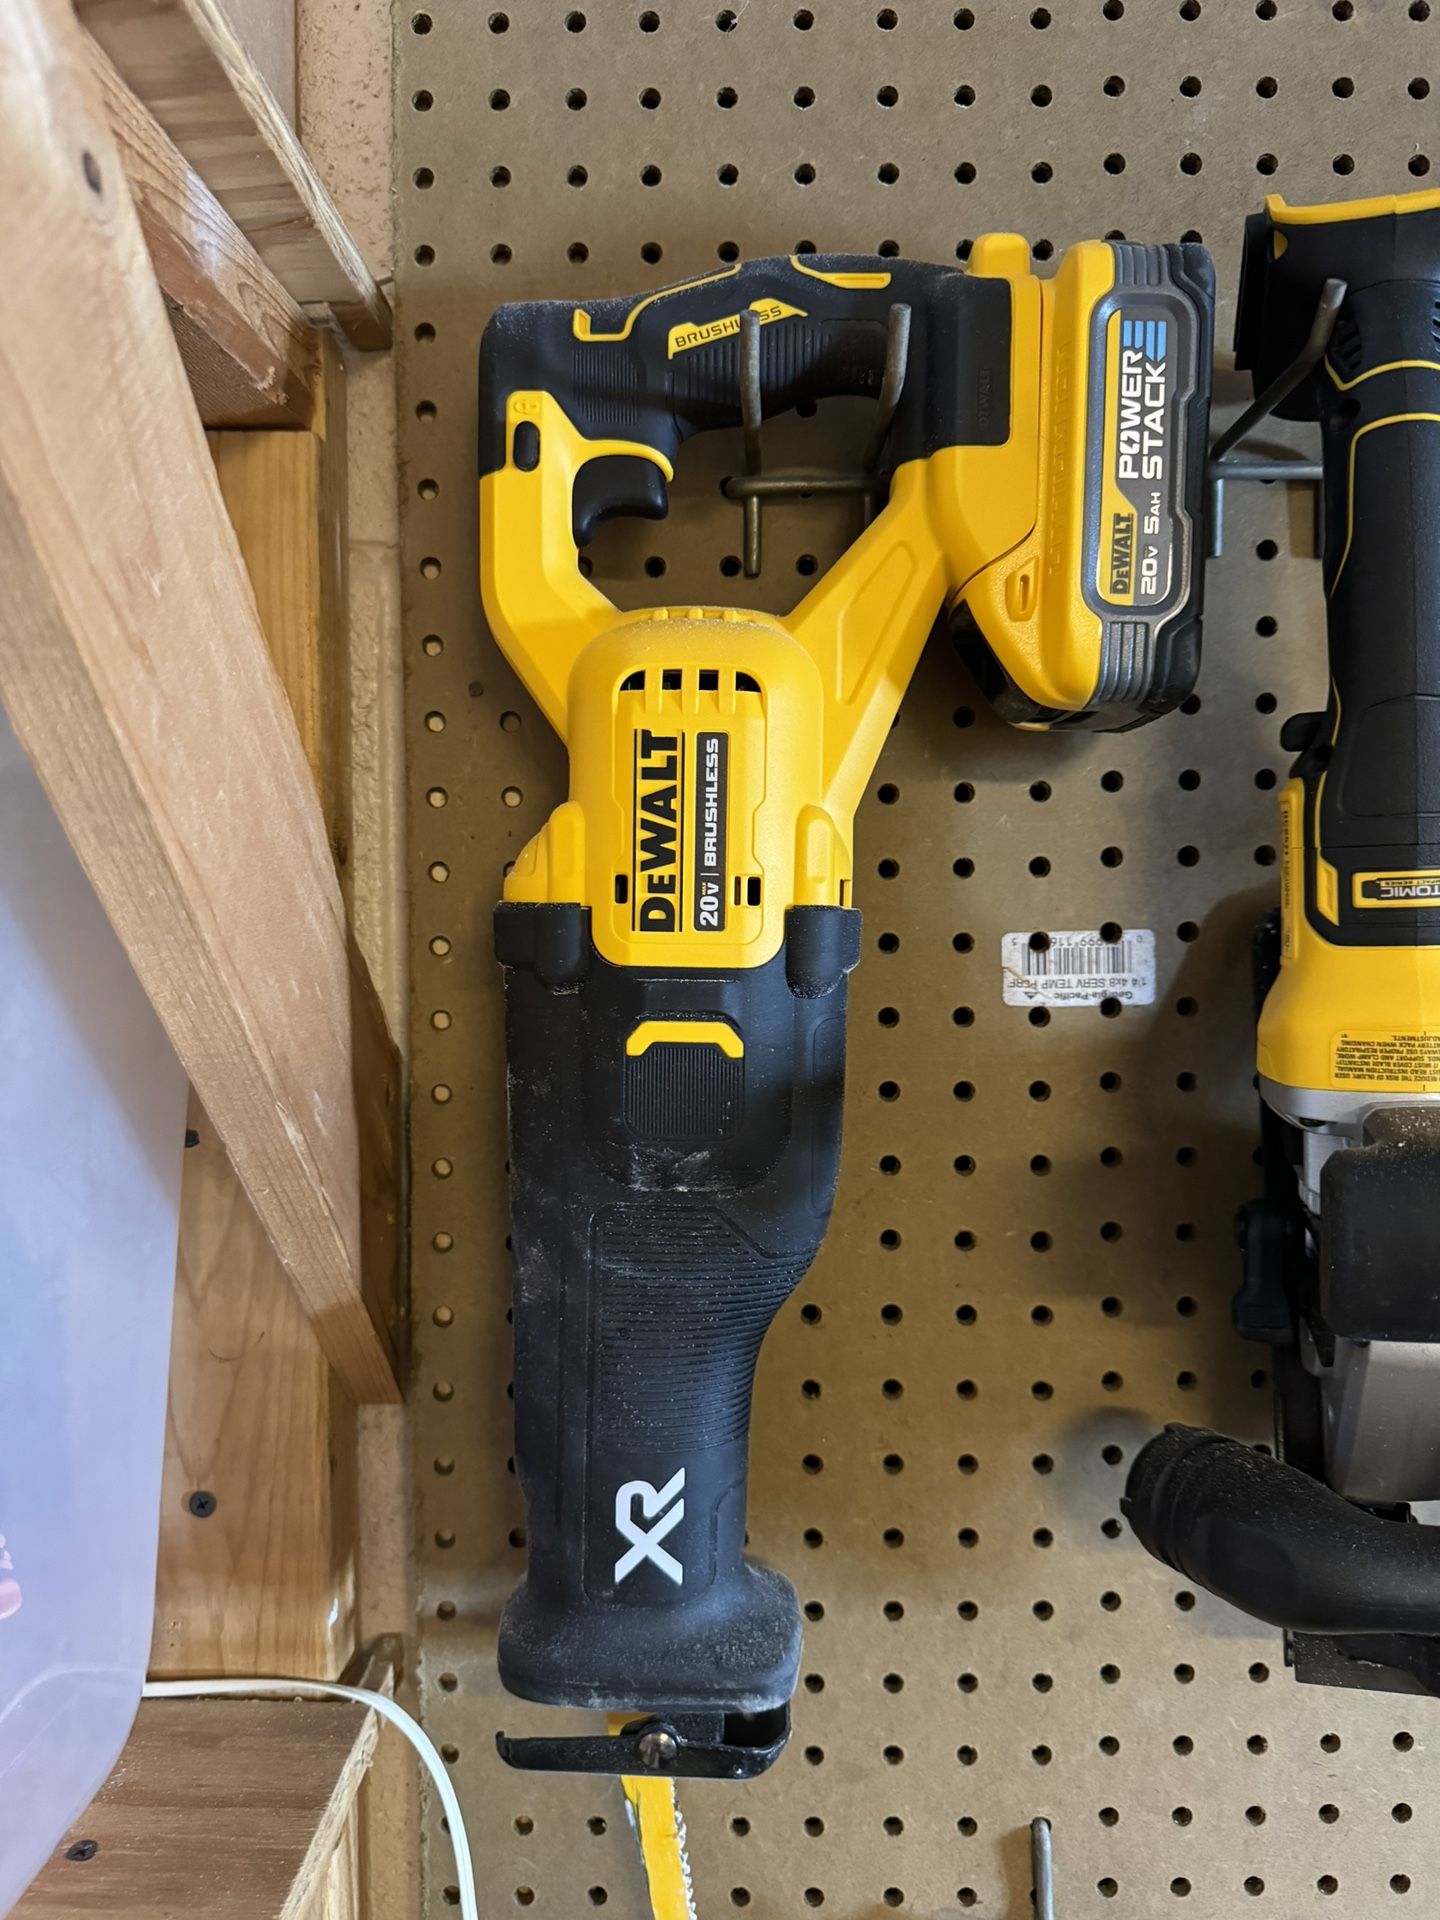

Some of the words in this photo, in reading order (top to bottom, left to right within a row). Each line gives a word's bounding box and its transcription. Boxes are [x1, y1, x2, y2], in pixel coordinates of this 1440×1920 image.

[675, 306, 782, 348] BRUSHLSS
[1119, 350, 1143, 479] POWER
[1142, 362, 1166, 479] STACK
[704, 738, 719, 867] BRUSHLESS
[1050, 937, 1072, 947] 116
[1008, 979, 1039, 989] PERF
[1041, 979, 1073, 989] TEMP
[1076, 978, 1106, 988] SERV
[1131, 978, 1147, 987] 1/4
[1054, 990, 1133, 1000] Georgia-Pacific
[615, 1467, 685, 1586] XR
